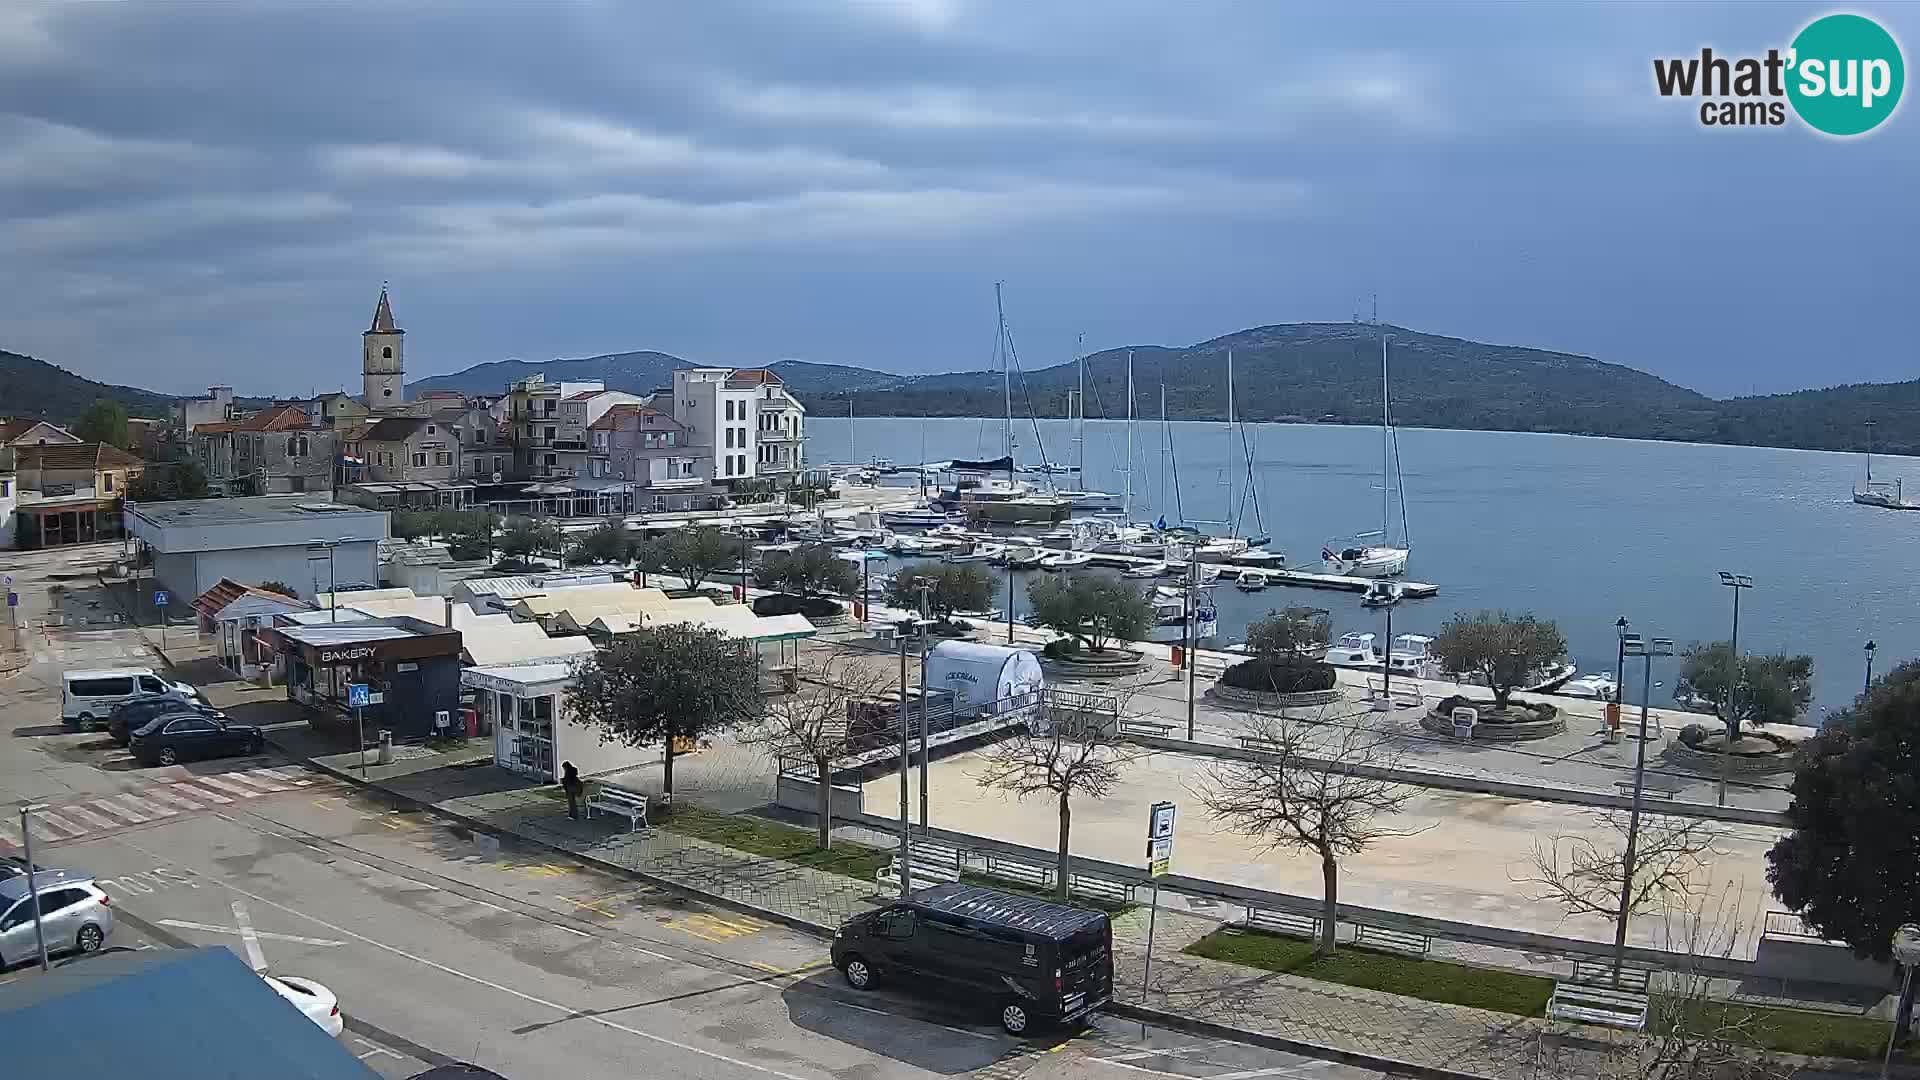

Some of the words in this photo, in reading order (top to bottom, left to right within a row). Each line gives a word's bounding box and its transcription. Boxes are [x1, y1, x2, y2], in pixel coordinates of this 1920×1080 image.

[322, 647, 376, 661] BAKERY
[945, 671, 956, 680] ICE
[957, 671, 979, 683] CREAM
